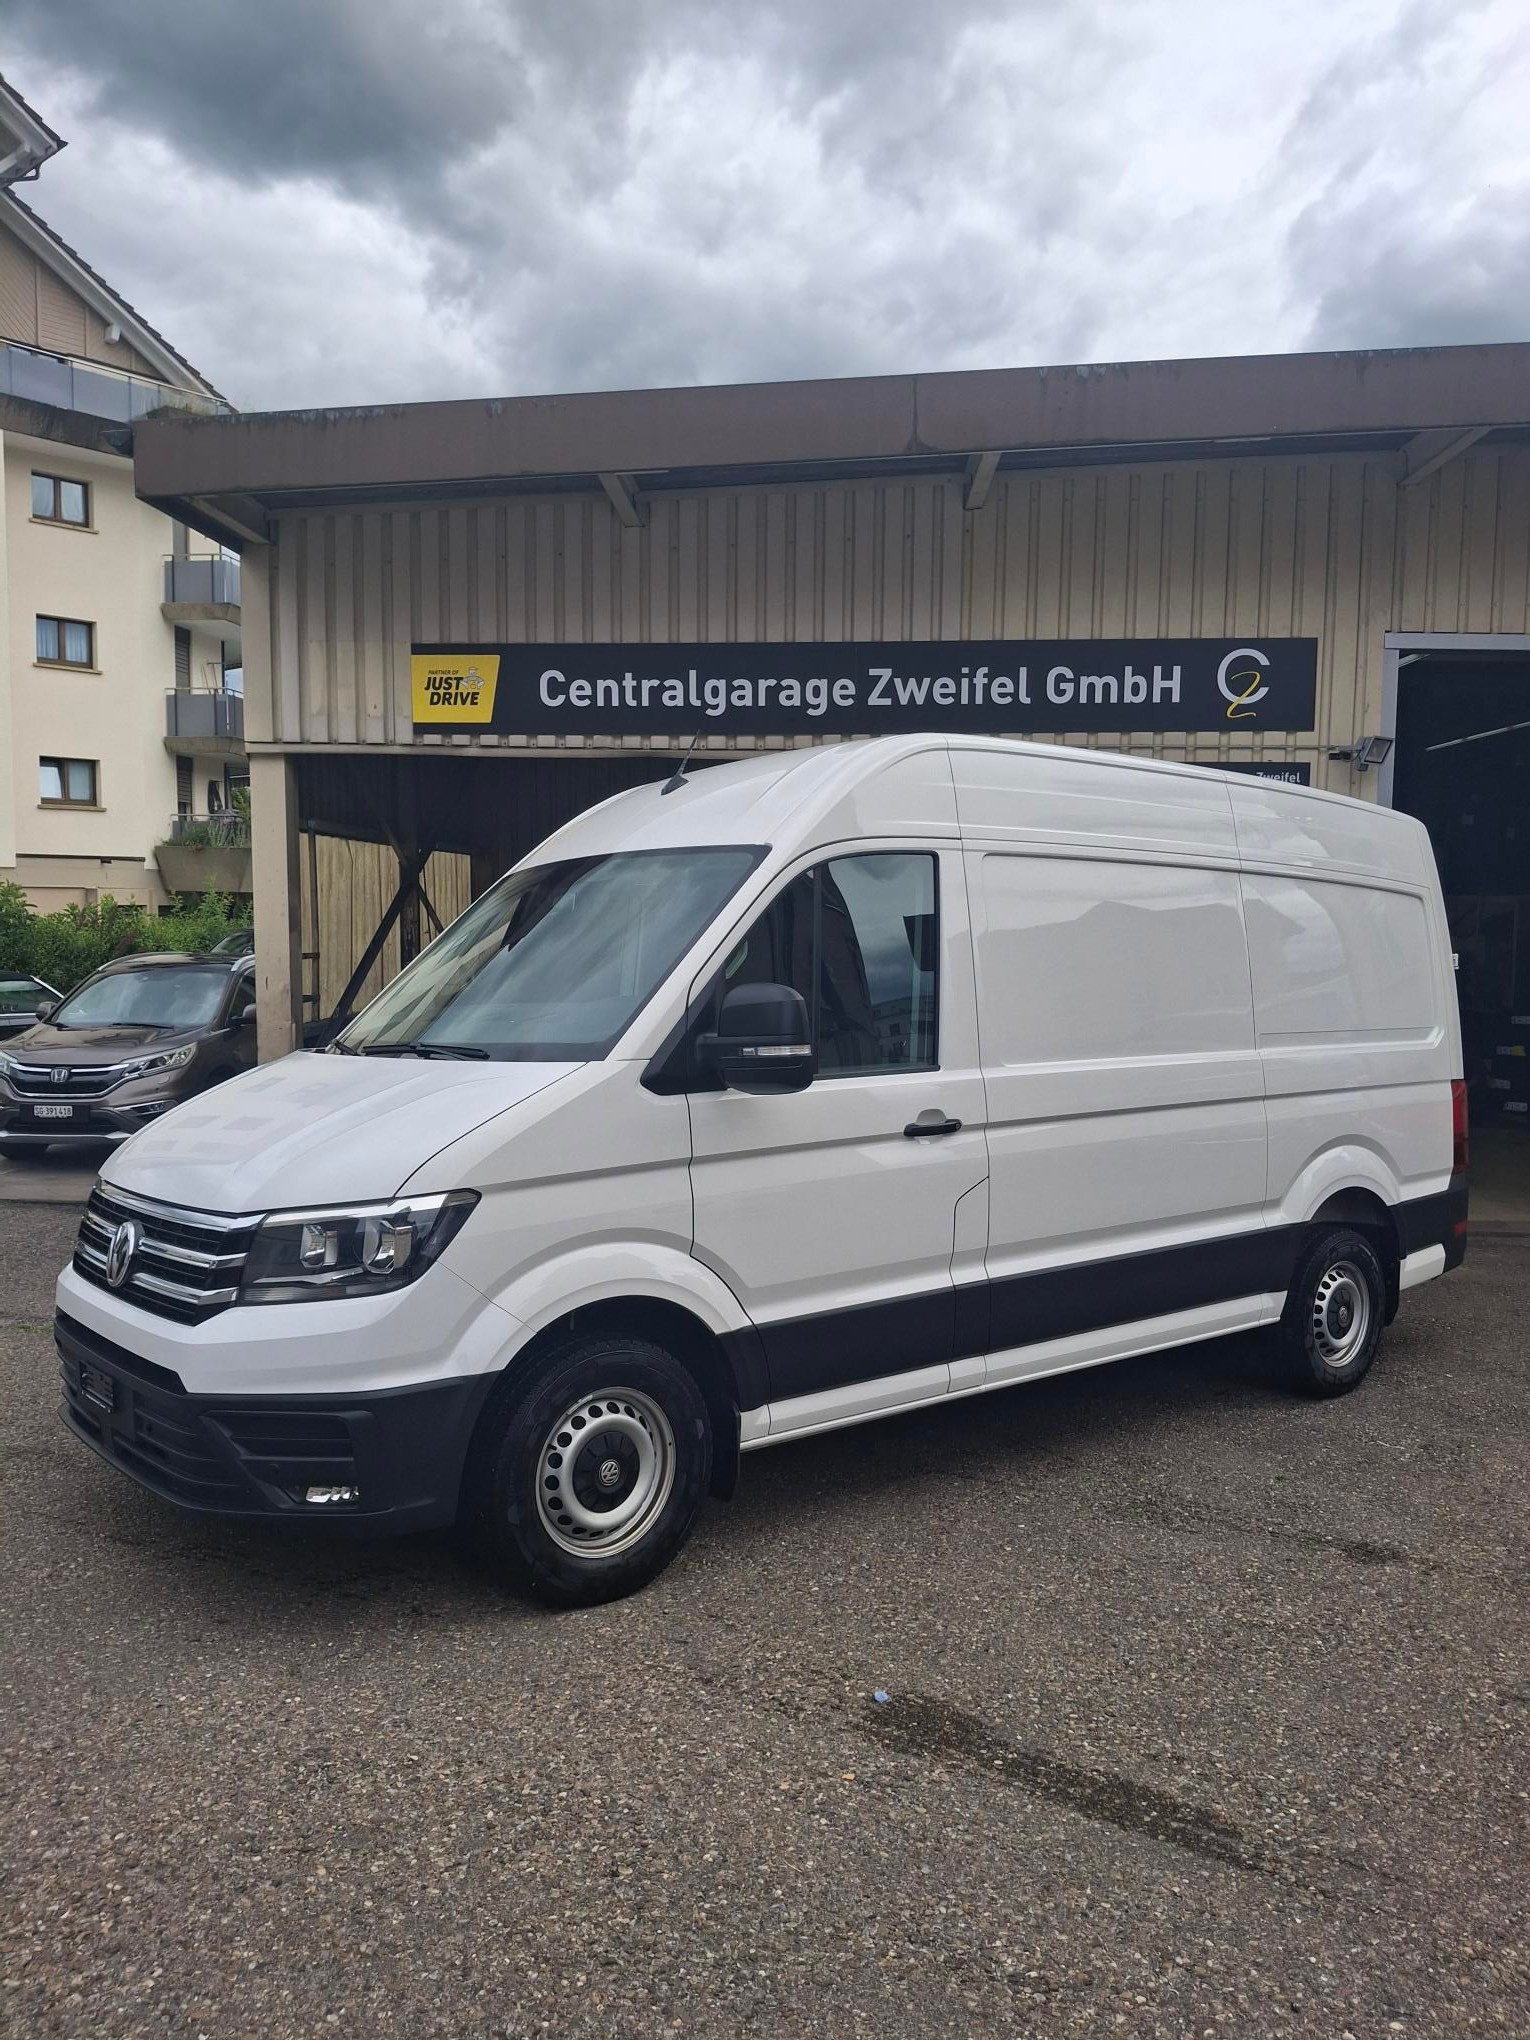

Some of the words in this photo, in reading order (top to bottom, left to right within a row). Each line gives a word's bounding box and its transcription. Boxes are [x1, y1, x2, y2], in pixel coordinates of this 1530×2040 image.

[424, 677, 464, 691] JUST
[539, 669, 856, 717] Centralgarage
[867, 666, 1032, 706] Zweifel
[1046, 665, 1182, 705] GmbH
[429, 692, 480, 706] DRIVE
